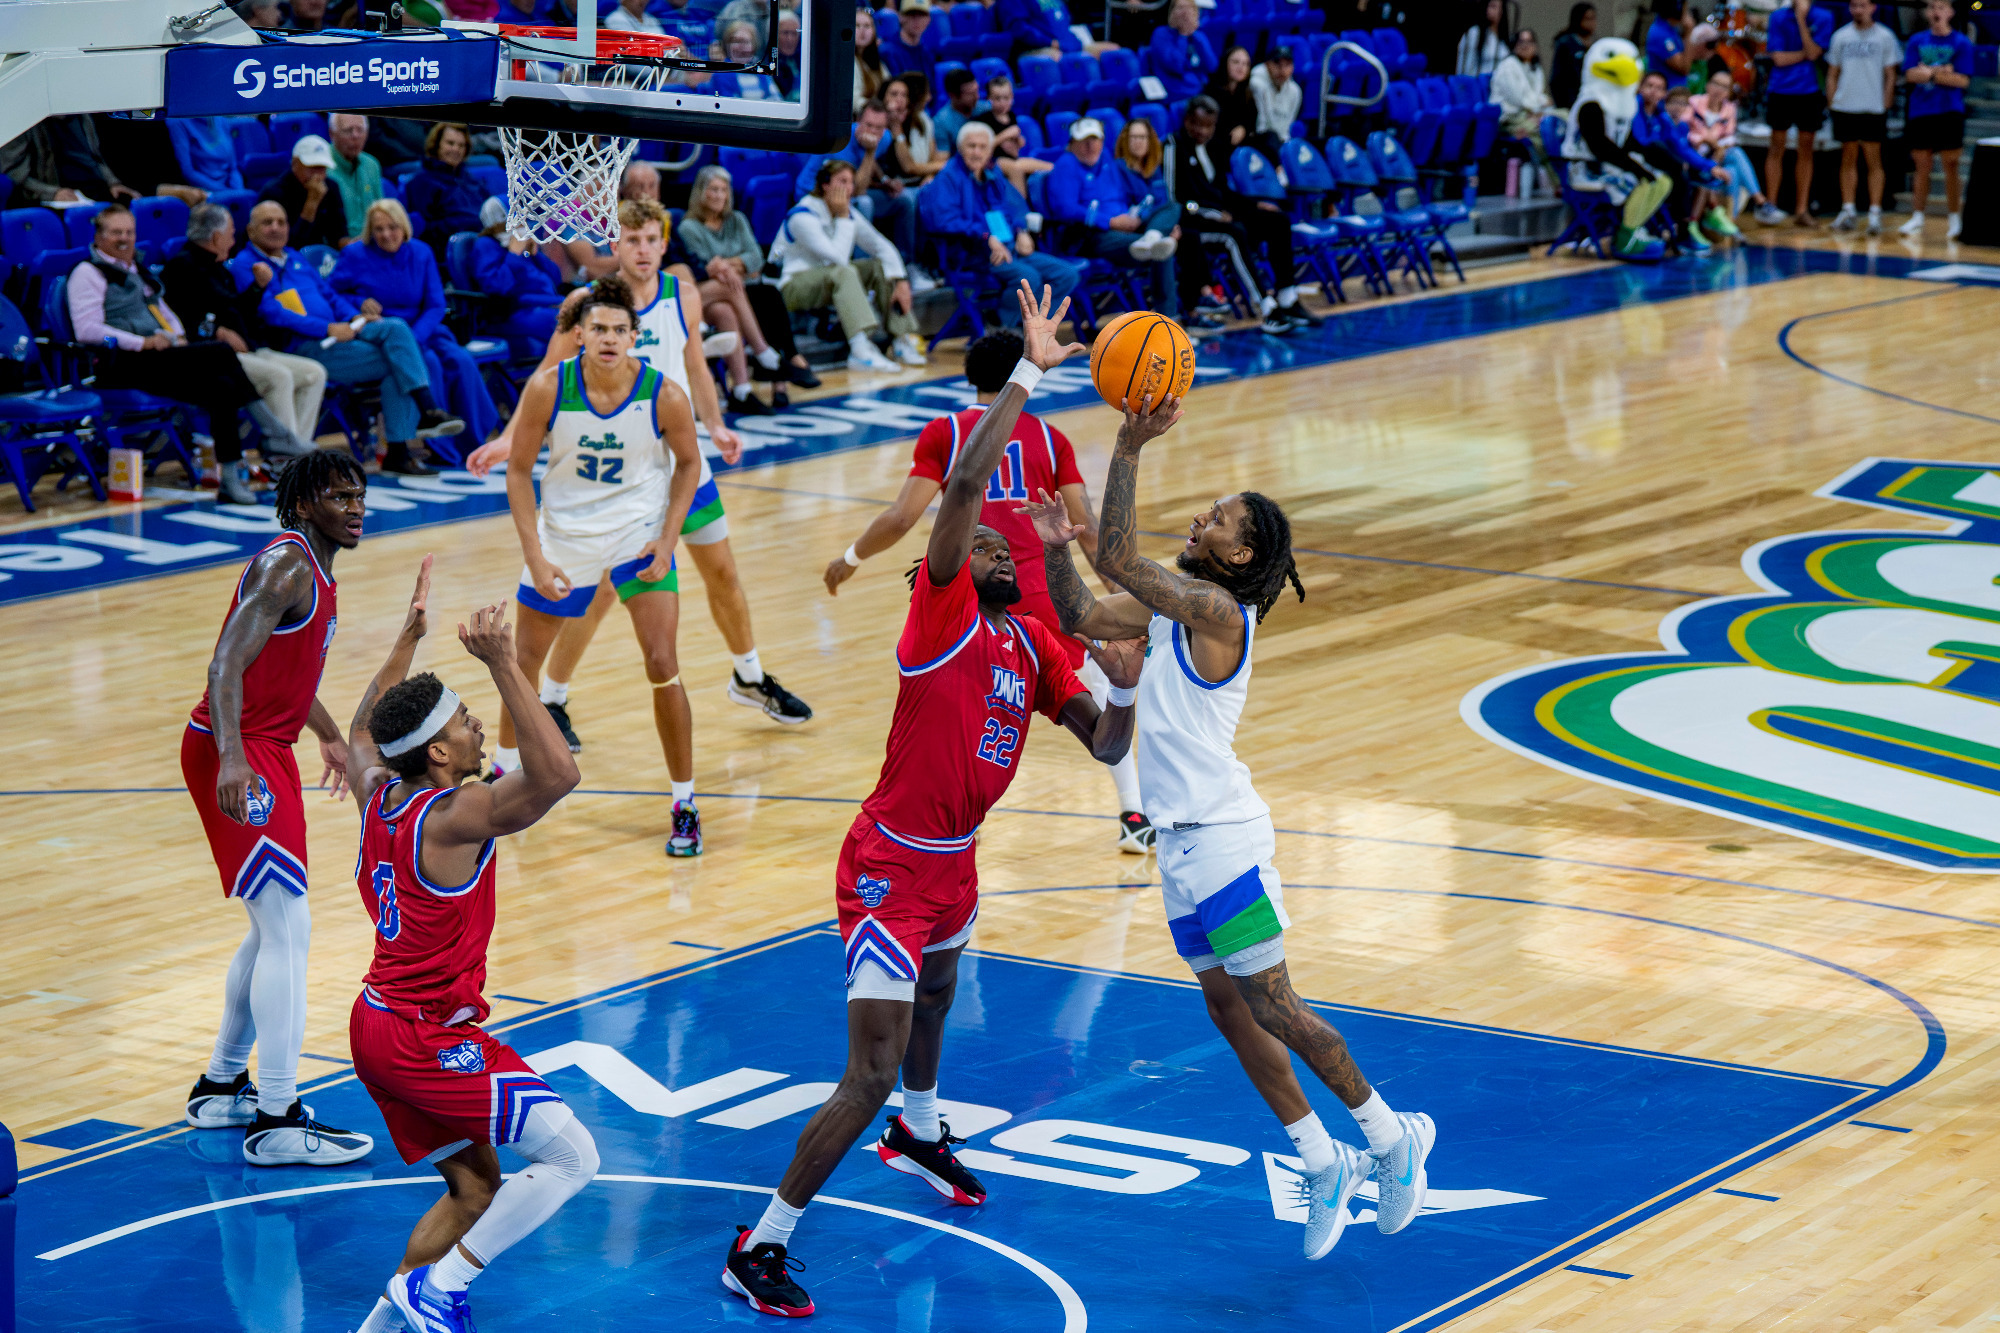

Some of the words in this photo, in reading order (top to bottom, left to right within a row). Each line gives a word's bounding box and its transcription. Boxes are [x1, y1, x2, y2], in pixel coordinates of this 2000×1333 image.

[273, 61, 363, 89] Schelde
[368, 57, 440, 88] Sports
[386, 83, 411, 95] Superior
[412, 84, 419, 94] by
[419, 82, 440, 93] Design
[578, 432, 624, 451] Eagles
[576, 454, 624, 484] 32
[976, 717, 1019, 768] 22
[372, 861, 401, 941] 0
